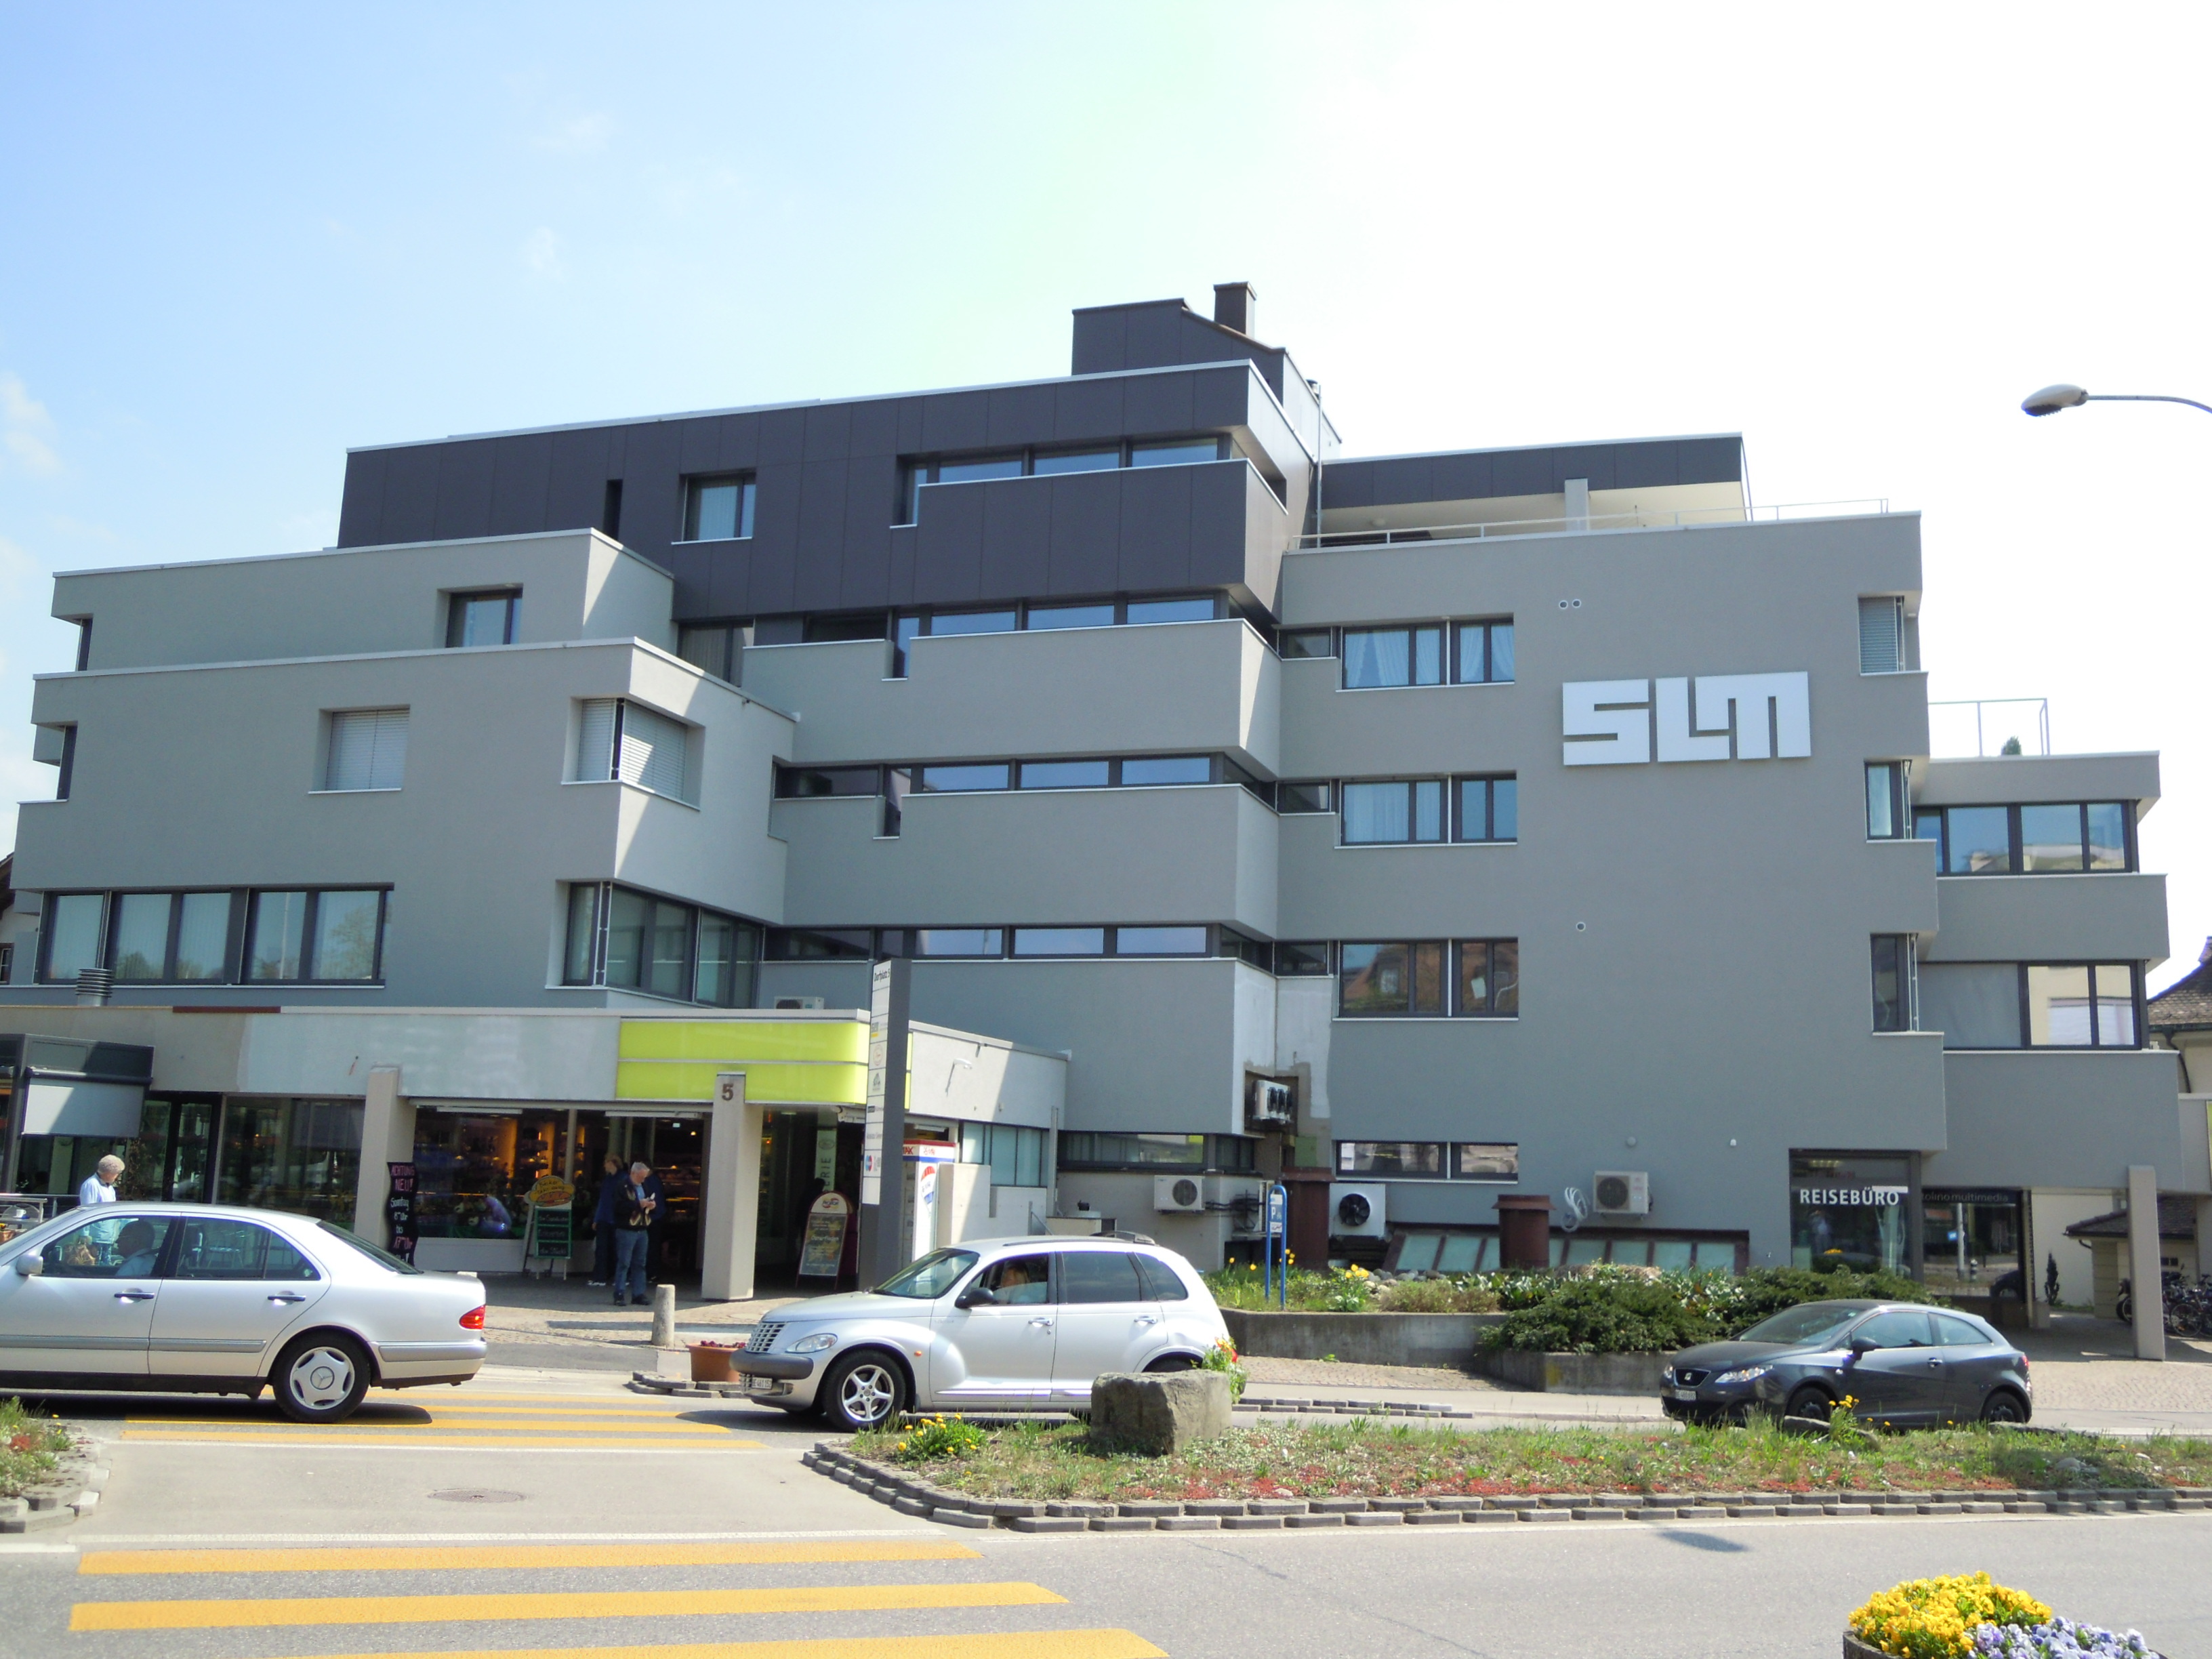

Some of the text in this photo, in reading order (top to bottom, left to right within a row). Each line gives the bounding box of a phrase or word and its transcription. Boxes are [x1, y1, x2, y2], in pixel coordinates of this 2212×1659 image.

[1562, 671, 1811, 766] SLM
[722, 1083, 734, 1101] 5
[391, 1164, 415, 1177] ACHTUNG
[395, 1178, 413, 1193] NEU!
[1800, 1187, 1900, 1206] REISEBÜRO
[1951, 1191, 2009, 1202] multimedia
[1271, 1206, 1276, 1219] P
[396, 1224, 404, 1234] bis
